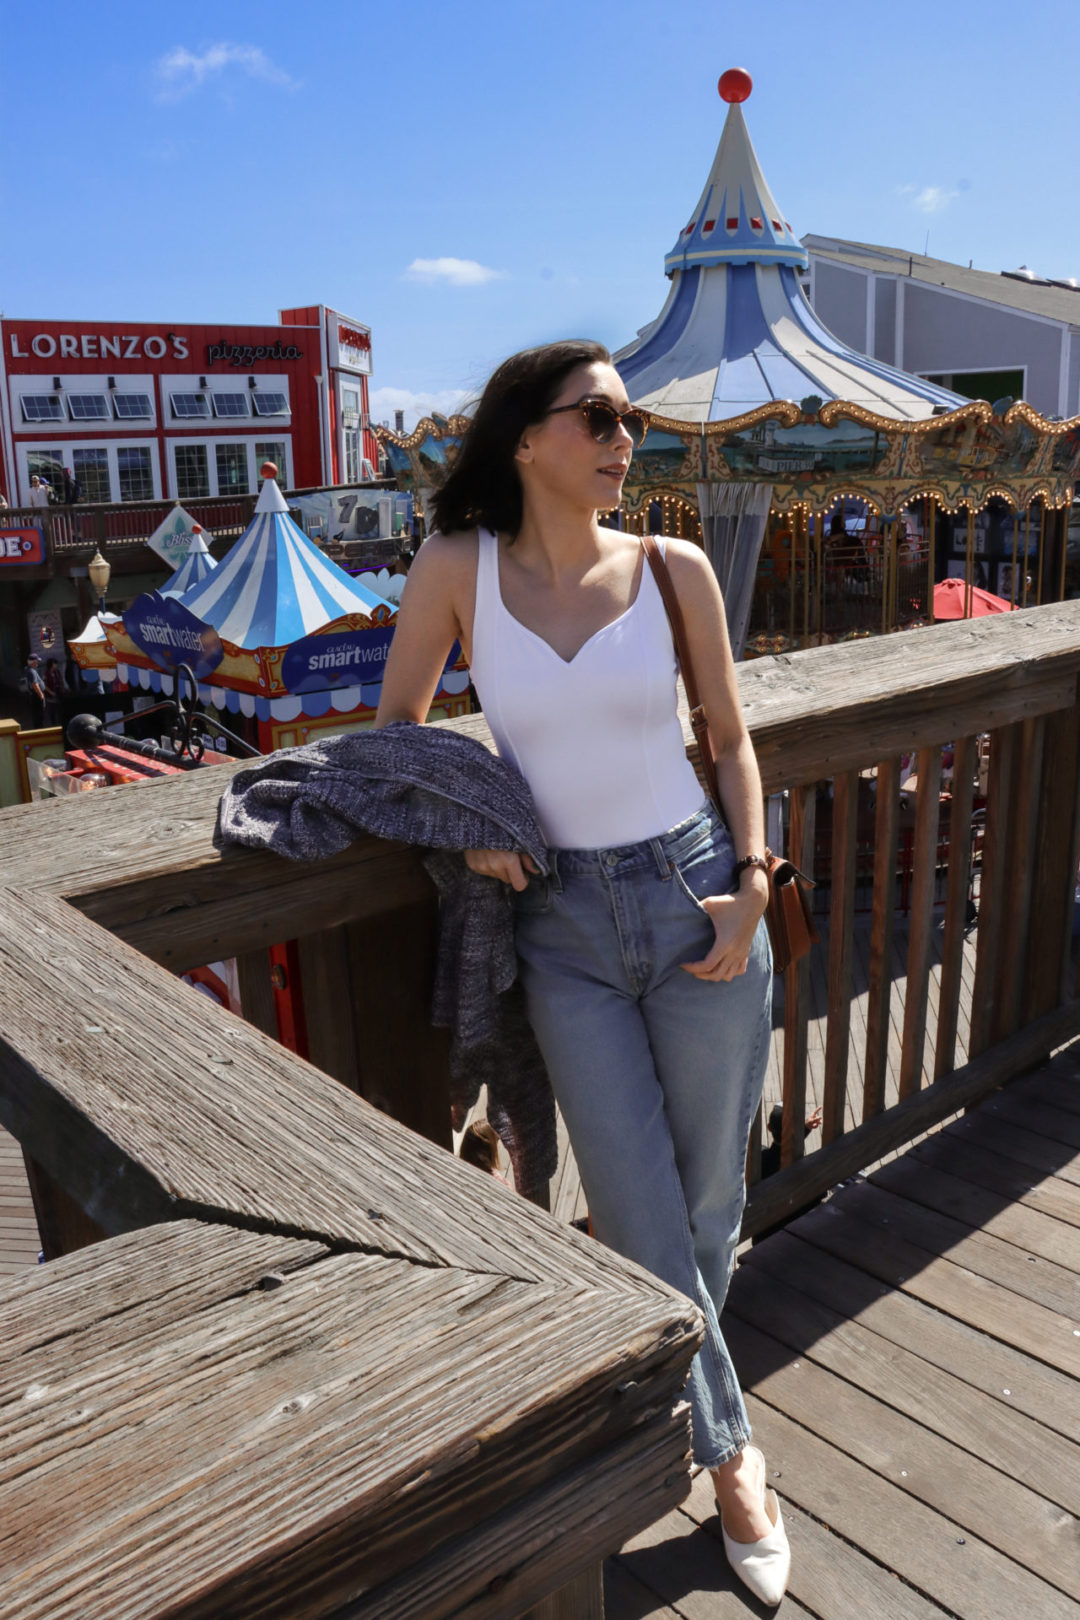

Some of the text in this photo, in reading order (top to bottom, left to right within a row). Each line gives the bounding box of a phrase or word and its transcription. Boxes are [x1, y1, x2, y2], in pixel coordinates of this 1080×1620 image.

[10, 333, 304, 367] LORENZO'S pizzeria
[140, 622, 206, 652] smartwater
[308, 642, 390, 671] smartwat
